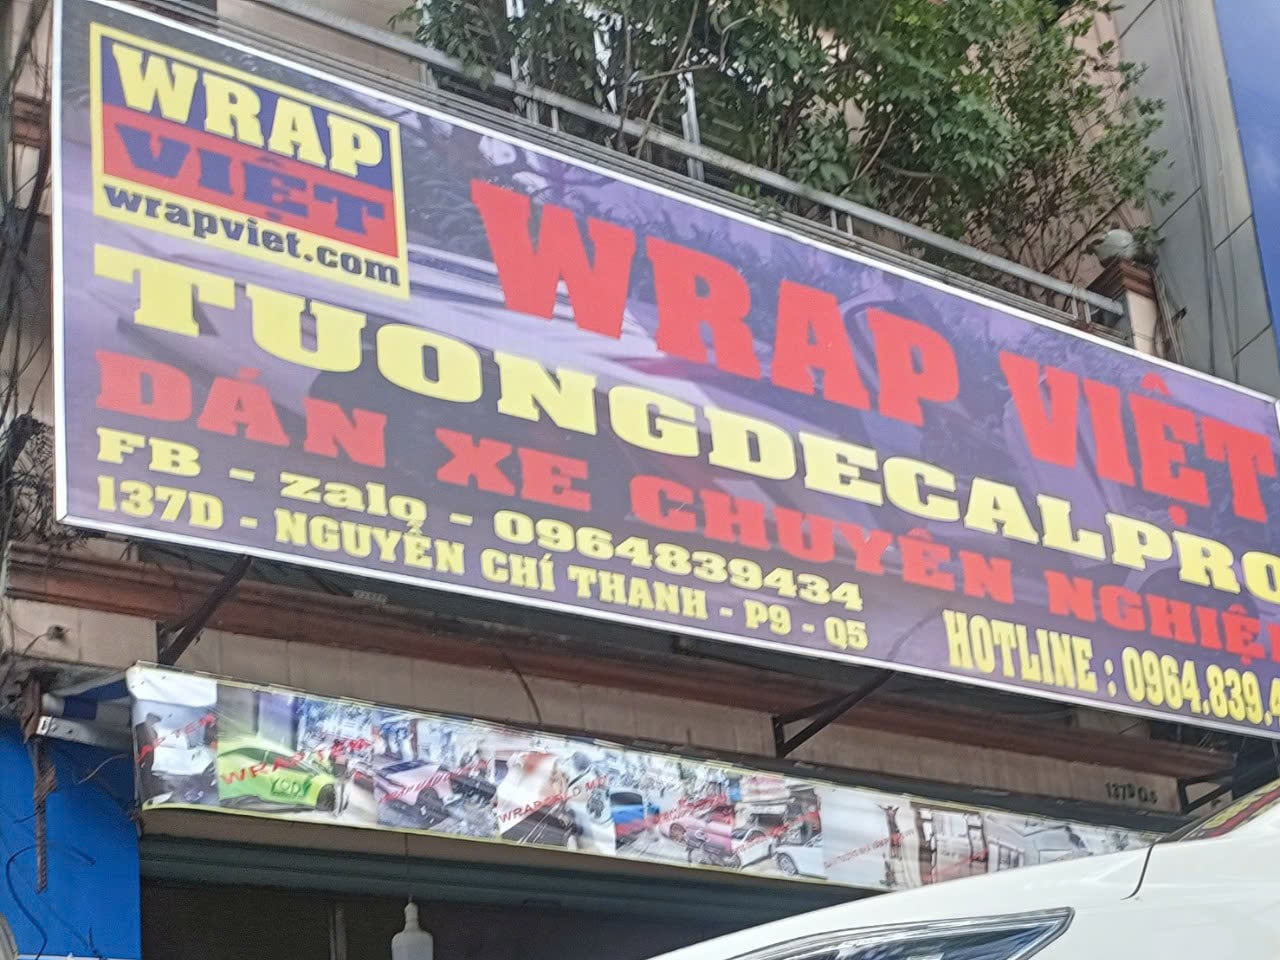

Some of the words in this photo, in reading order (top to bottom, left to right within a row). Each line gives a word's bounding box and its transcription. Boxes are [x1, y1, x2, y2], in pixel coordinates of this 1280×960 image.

[112, 43, 383, 178] WRAP
[114, 123, 385, 235] VIỆT
[103, 184, 401, 286] wrapviet.com
[470, 178, 960, 427] WRAP
[1000, 350, 1277, 526] VIỆT
[96, 350, 388, 468] DÁN
[435, 428, 592, 511] XE
[629, 475, 1015, 604] CHUYÊN
[96, 427, 201, 477] FB
[494, 510, 864, 611] 0964839434
[97, 475, 223, 529] 137D
[481, 548, 556, 591] CHÍ
[567, 565, 708, 620] THANH
[744, 600, 791, 635] P9
[942, 609, 1098, 694] HOTLINE
